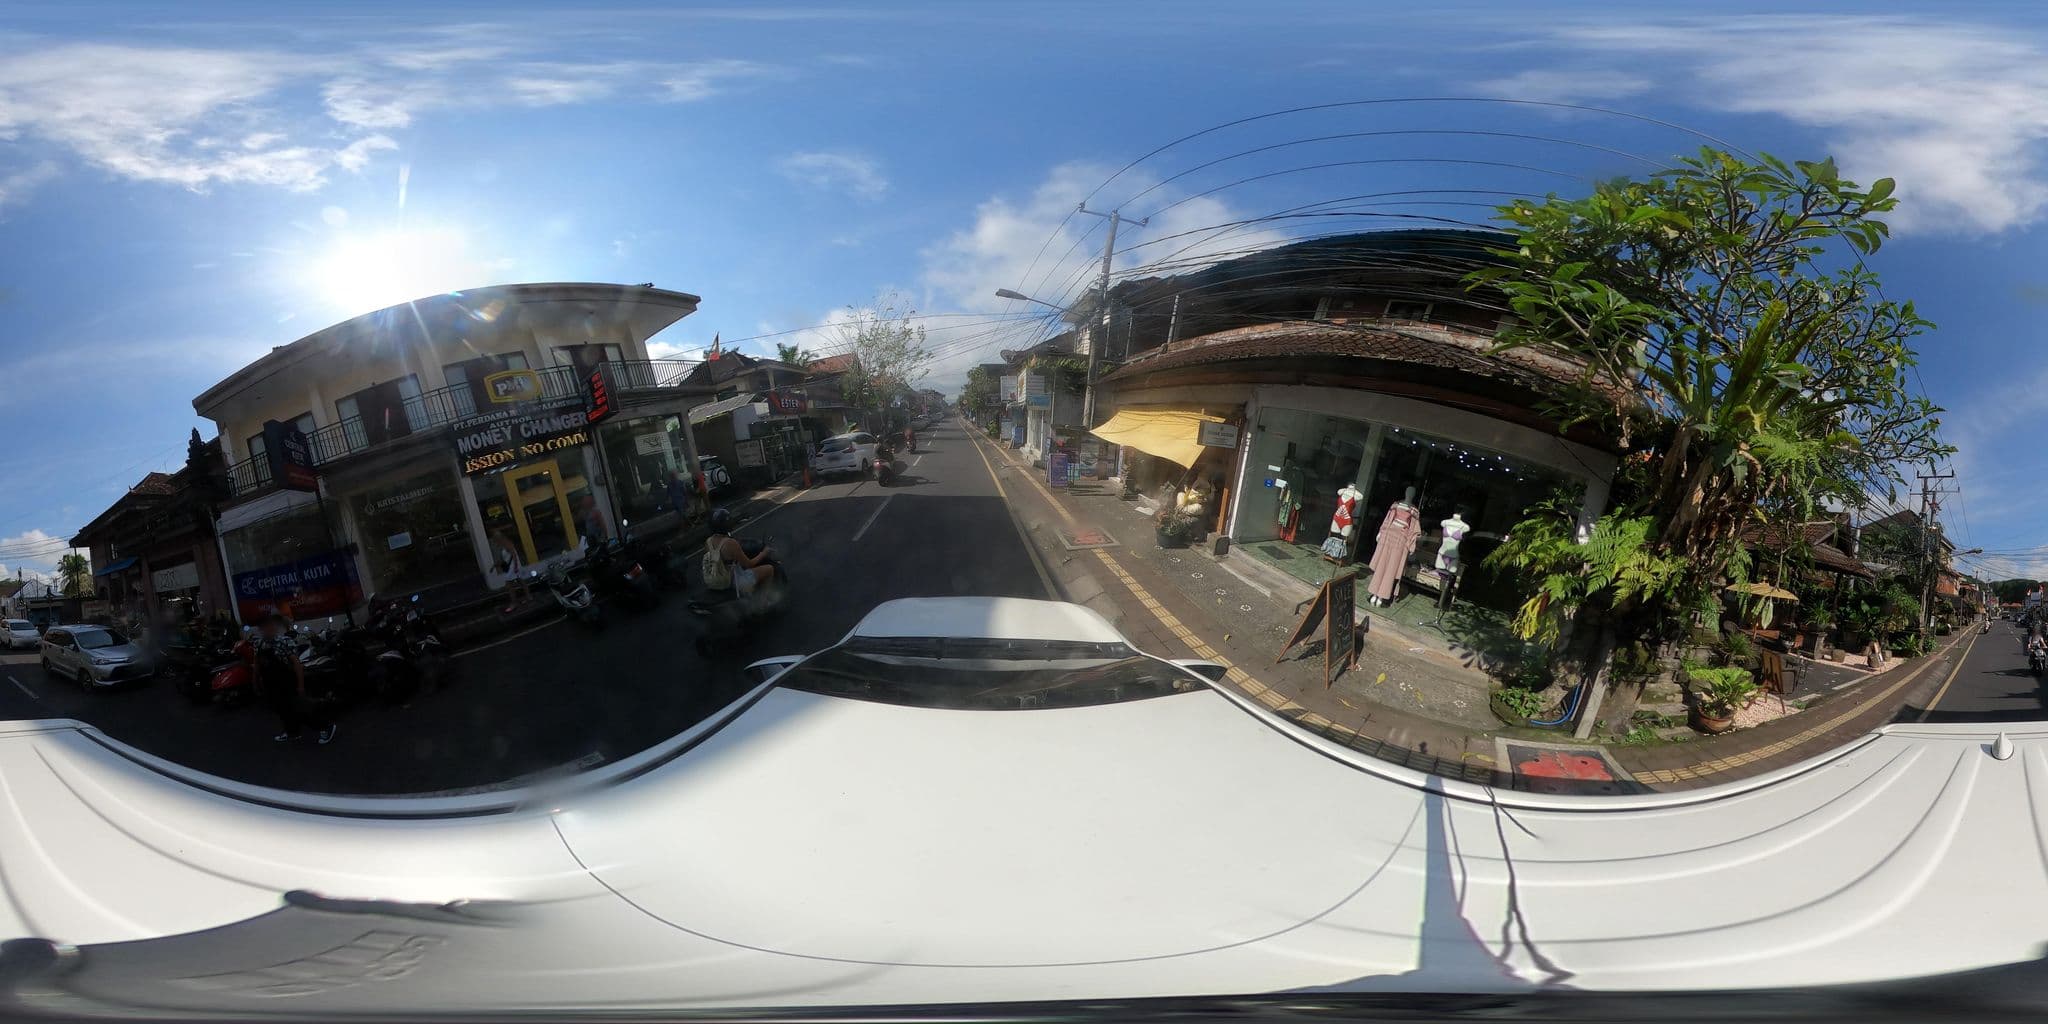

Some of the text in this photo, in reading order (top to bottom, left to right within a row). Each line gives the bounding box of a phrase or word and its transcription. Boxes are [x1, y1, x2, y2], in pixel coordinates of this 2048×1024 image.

[457, 425, 513, 455] MONEY
[520, 411, 589, 439] CHANGER
[520, 442, 545, 458] NO
[257, 571, 300, 591] CENTRAL
[303, 564, 331, 581] KUTA
